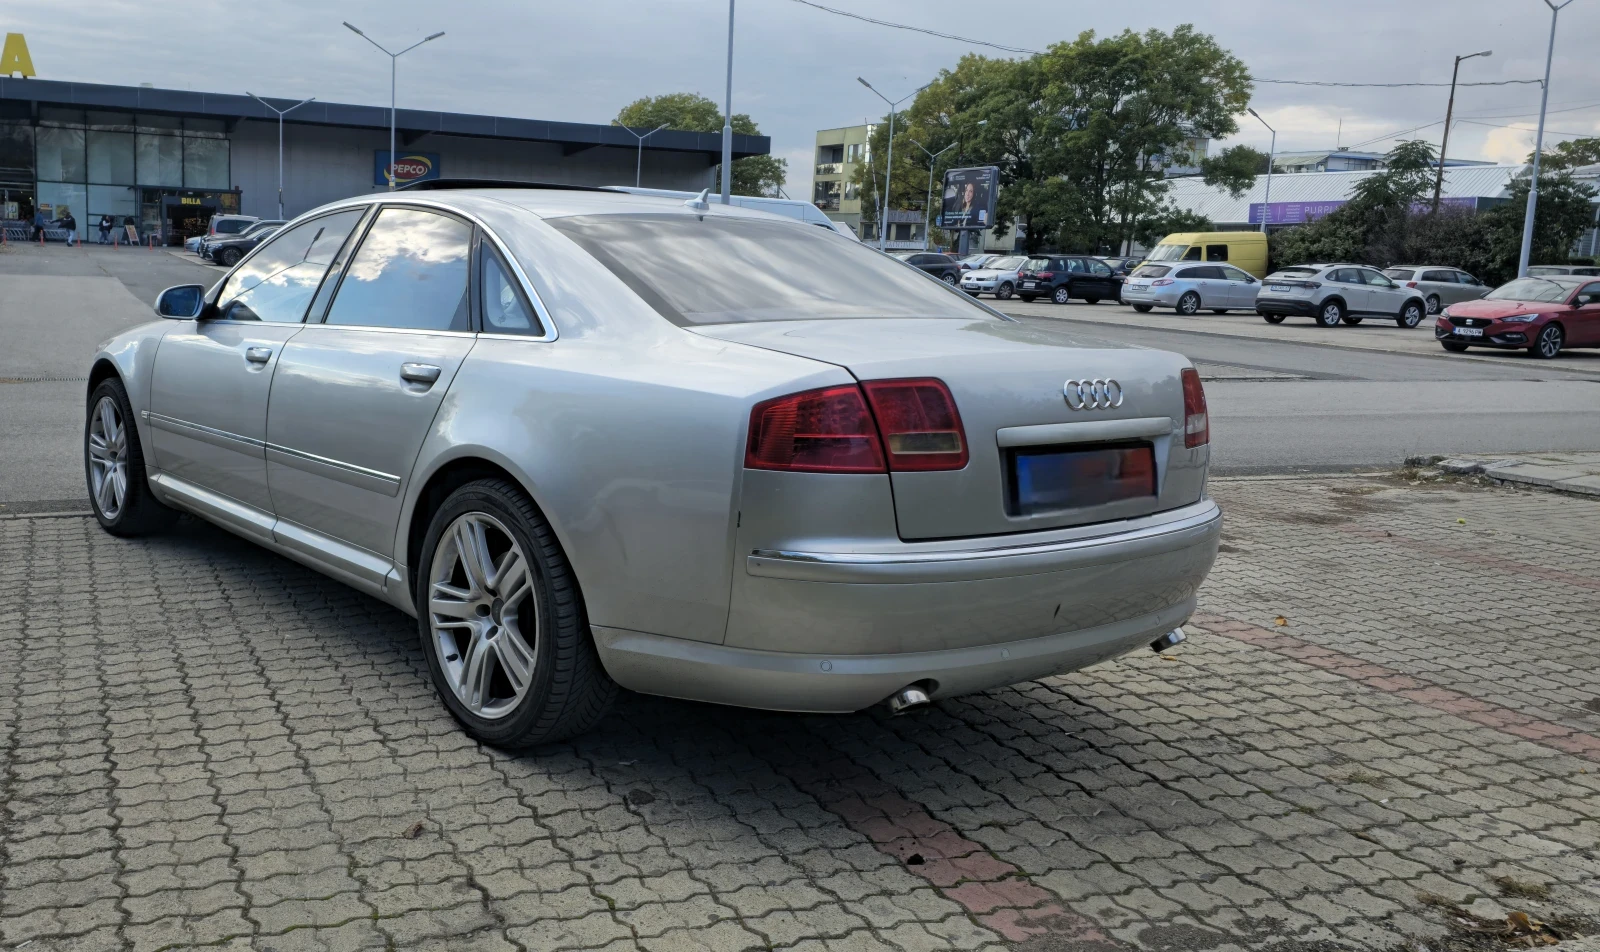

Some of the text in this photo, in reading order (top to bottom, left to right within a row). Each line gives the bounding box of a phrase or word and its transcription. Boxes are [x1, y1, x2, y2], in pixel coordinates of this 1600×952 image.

[0, 33, 36, 76] A
[392, 164, 424, 174] PEPCO
[181, 197, 201, 205] BILLA
[1304, 205, 1339, 214] PURPL
